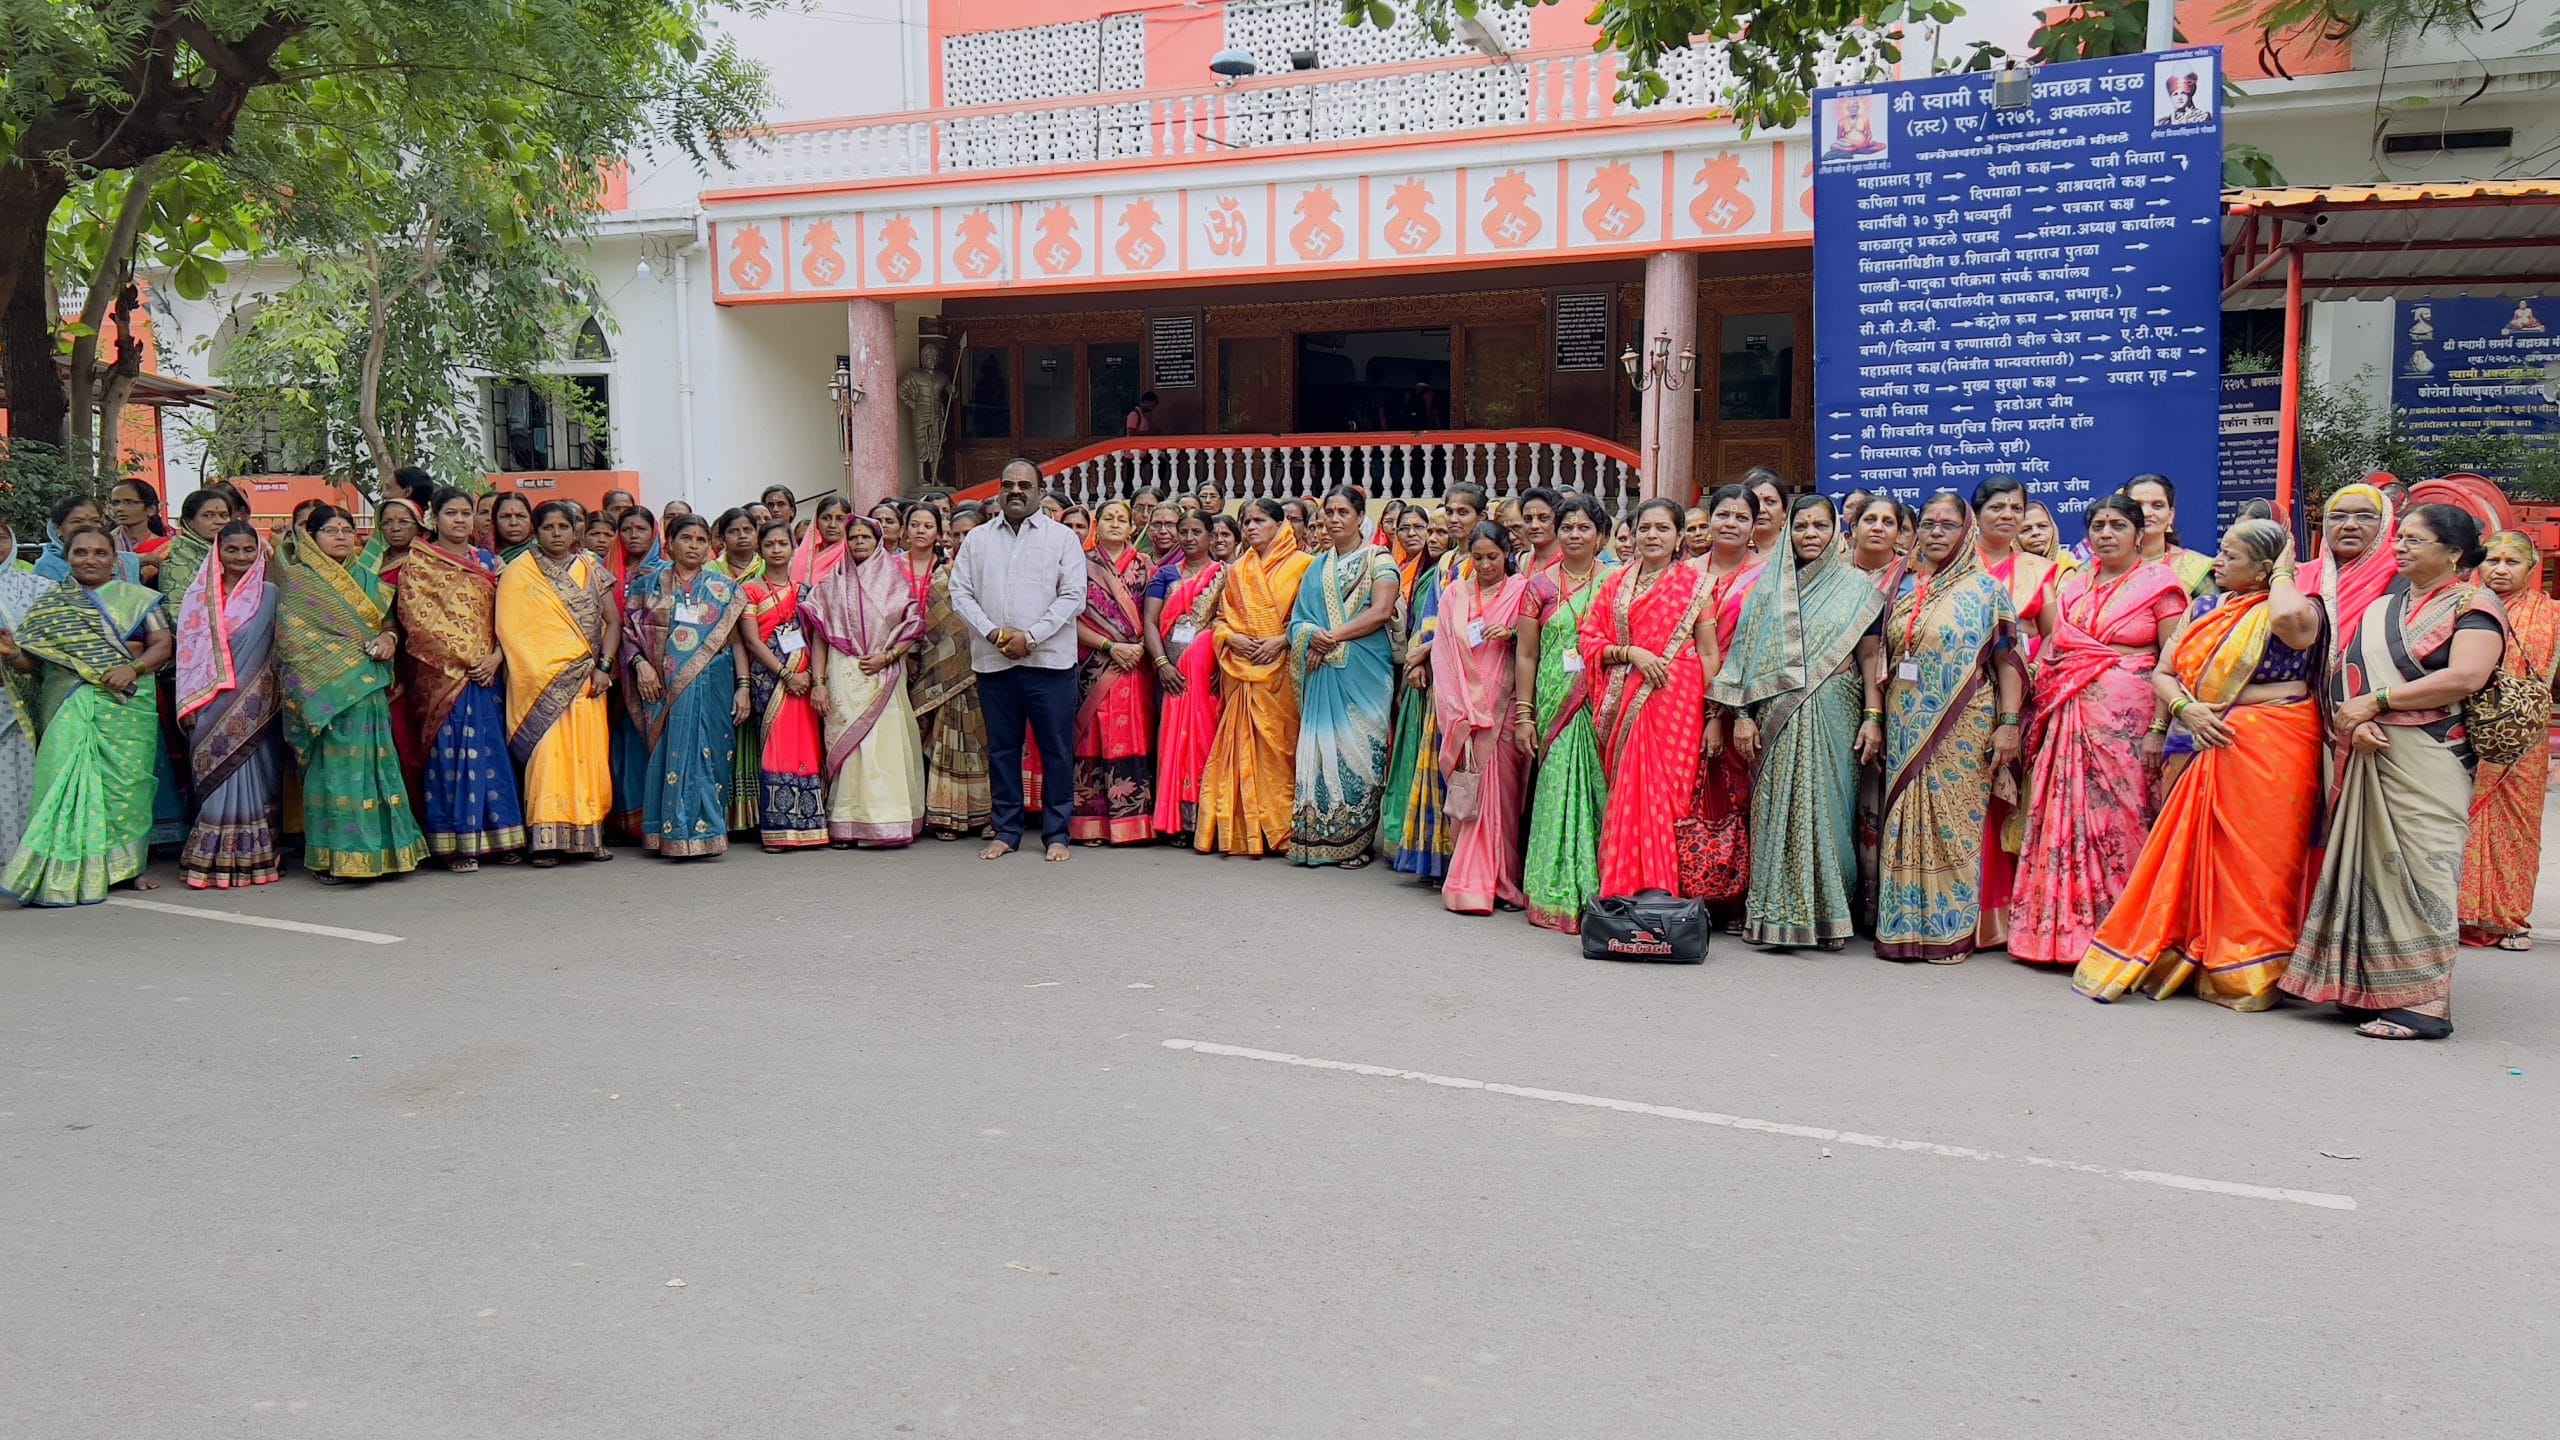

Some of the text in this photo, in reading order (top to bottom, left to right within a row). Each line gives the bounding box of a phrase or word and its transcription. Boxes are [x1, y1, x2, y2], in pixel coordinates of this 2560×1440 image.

[2031, 68, 2145, 99] अन्नछत्र मंडळ
[1893, 91, 1914, 112] श्री
[1921, 86, 1971, 112] स्वामी
[1906, 117, 1948, 136] (ट्रस्ट)
[1996, 108, 2041, 126] २२७९,
[2049, 97, 2132, 121] अक्कलकोट
[2090, 150, 2165, 167] यात्री निवारा
[1988, 162, 2050, 178] देणगी कक्ष
[1857, 172, 1932, 190] महाप्रसाद गृह
[2056, 173, 2146, 193] आश्रयदाते कक्ष
[1857, 194, 1926, 209] कपिला गाय
[1970, 185, 2022, 201] दिपमाळा
[2062, 198, 2134, 213] पत्रकार कक्ष
[1913, 216, 1928, 227] ३०
[1934, 209, 1959, 229] फुटी
[2121, 214, 2176, 232] कार्यालय
[1858, 237, 1913, 253] वारुळातून
[1918, 230, 1957, 247] प्रकटले
[1859, 254, 1944, 273] सिंहासनाधिष्ठीत
[2016, 247, 2060, 263] महाराज
[2064, 244, 2100, 262] पुतळा
[1859, 264, 2089, 294] पालखी-पादुका परिक्रमा संपर्क कार्यालय
[1859, 299, 1893, 315] स्वामी
[1999, 290, 2059, 305] कामकाज,
[1974, 311, 2037, 330] कंट्रोल रूम
[2070, 306, 2137, 323] प्रसाधन गृह
[1940, 340, 1950, 351] व
[1954, 333, 2012, 351] रुग्णासाठी
[2016, 331, 2046, 347] व्हील
[2051, 329, 2081, 344] चेअर
[2120, 324, 2178, 342] ए.टी.एम.
[2110, 346, 2182, 363] अतिथी कक्ष
[1859, 363, 1912, 378] महाप्रसाद
[2107, 370, 2167, 386] उपहार गृह
[1913, 383, 1930, 395] रथ
[1962, 376, 2057, 396] मुख्य सुरक्षा कक्ष
[2418, 384, 2450, 398] कोरोना
[1860, 402, 1929, 418] यात्री निवास
[1994, 393, 2074, 413] इनडोअर जीम
[1860, 413, 2094, 440] श्री शिवचरित्र धातुचित्र शिल्प प्रदर्शन हॉल
[2252, 415, 2274, 426] सेवा
[1860, 445, 1922, 460] शिवस्मारक
[1860, 457, 2050, 481] नवसाचा शमी विघ्नेश गणेश मंदिर
[2026, 478, 2090, 493] डोअर जीम
